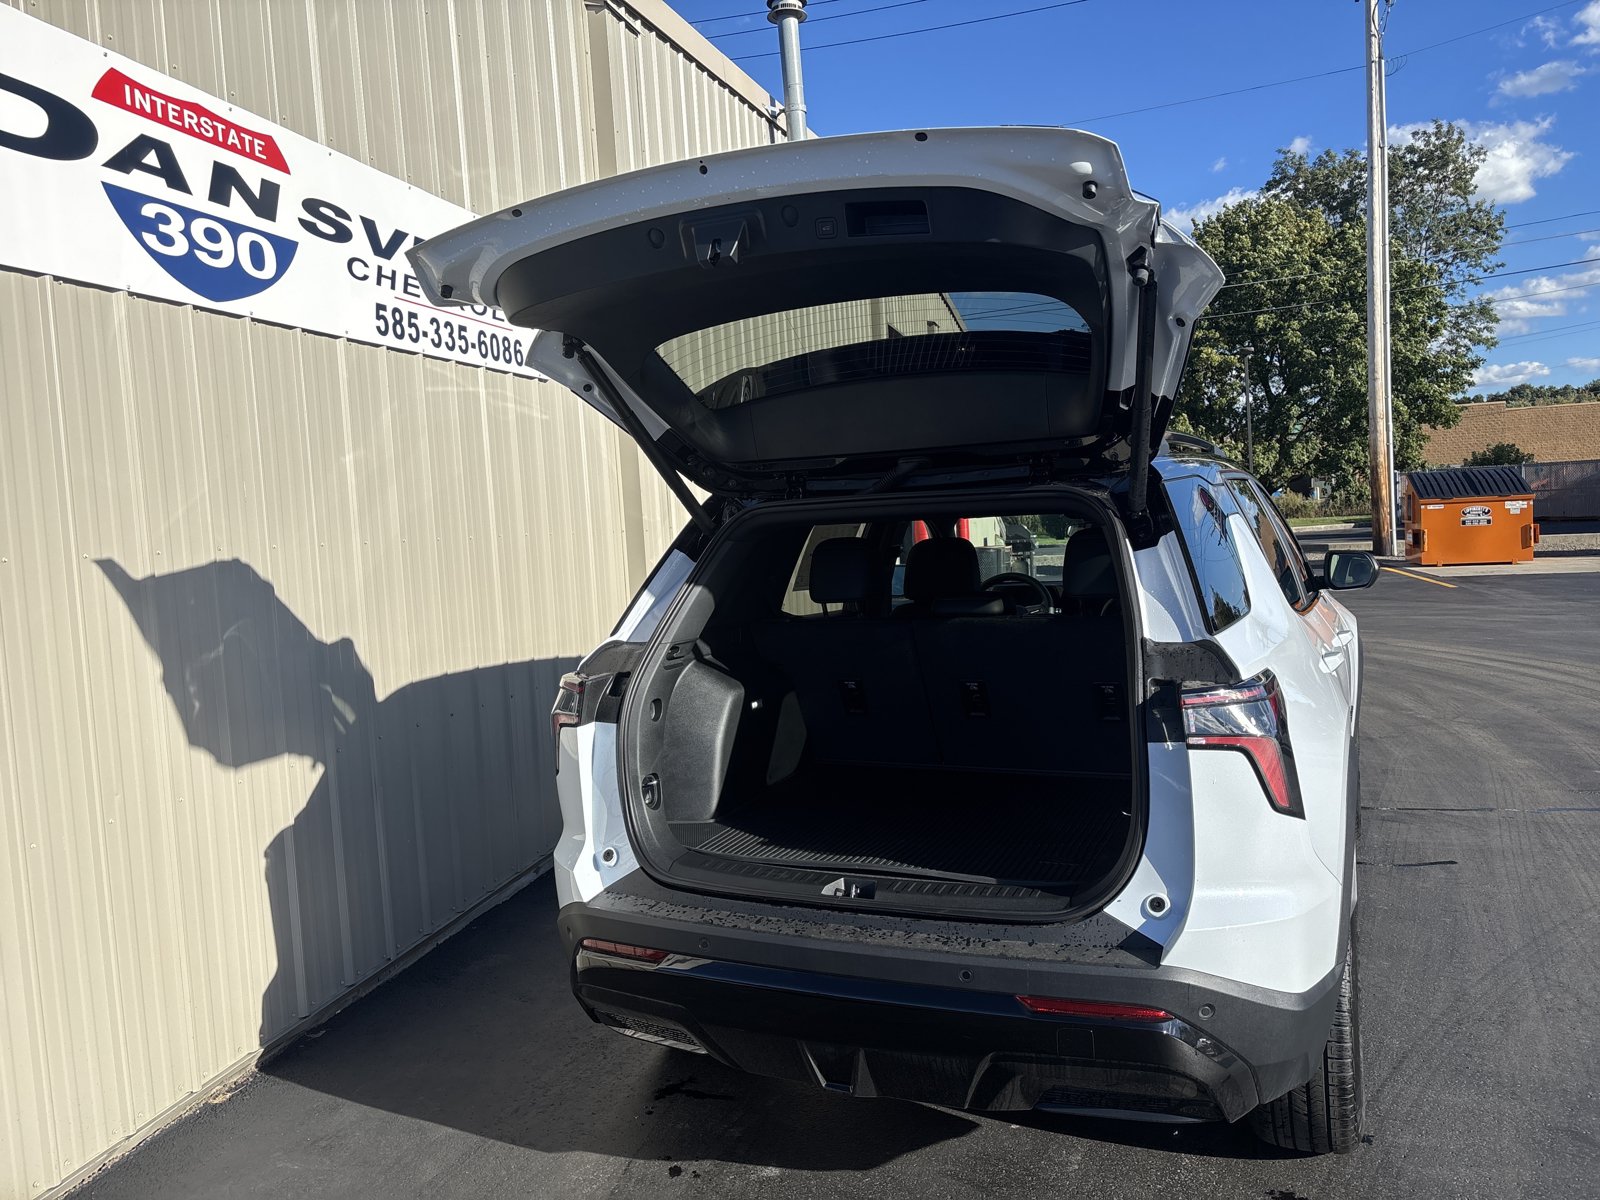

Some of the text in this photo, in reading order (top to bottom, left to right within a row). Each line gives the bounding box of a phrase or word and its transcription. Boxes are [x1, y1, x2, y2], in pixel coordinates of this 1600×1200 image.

[124, 84, 267, 160] INTERSTATE
[0, 73, 426, 261] DANSV
[140, 202, 278, 280] 390
[375, 302, 524, 367] 585-335-6086
